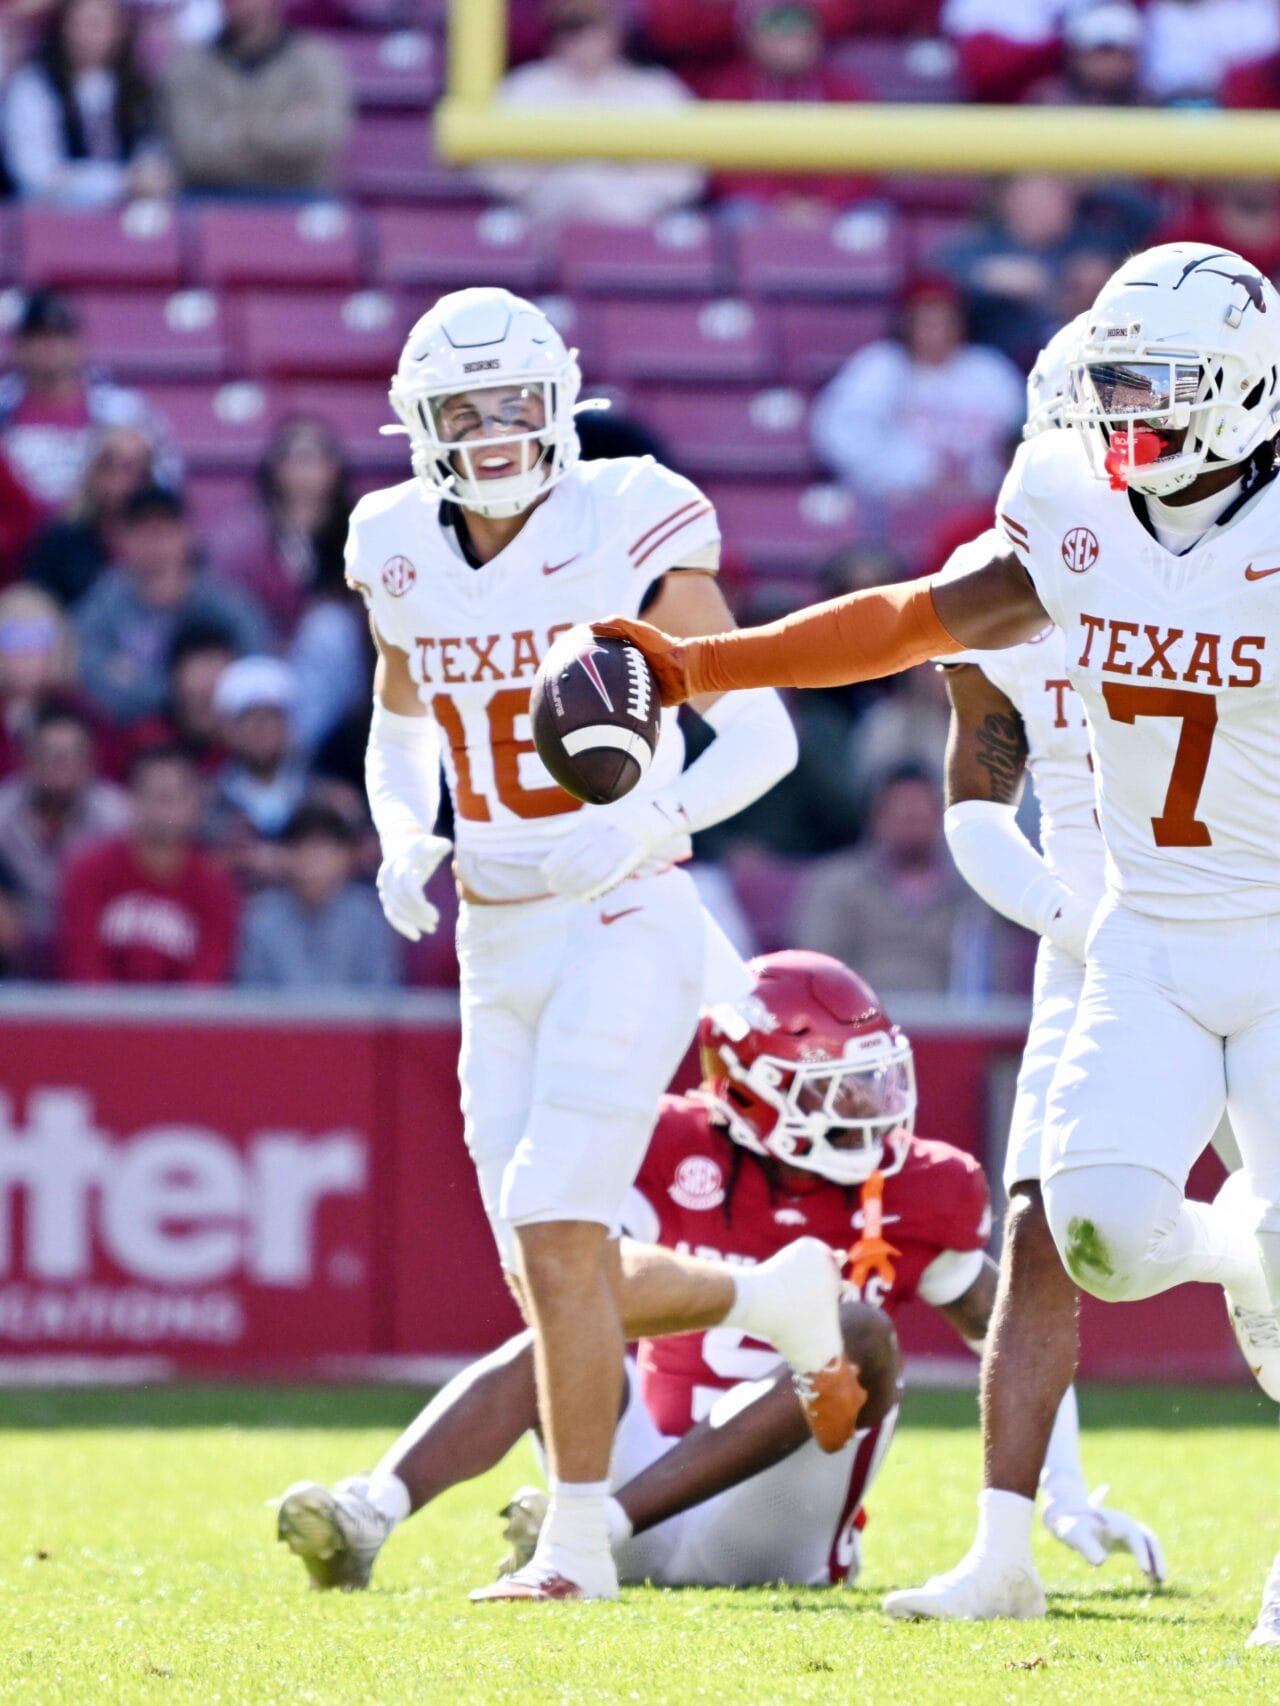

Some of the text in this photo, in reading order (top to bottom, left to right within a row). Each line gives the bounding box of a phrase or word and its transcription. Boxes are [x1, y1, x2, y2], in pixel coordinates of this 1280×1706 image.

[1062, 527, 1099, 573] SEC
[415, 623, 573, 683] TEXA
[1078, 613, 1265, 688] TEXAS
[1102, 681, 1218, 847] 7
[0, 1084, 368, 1287] ter
